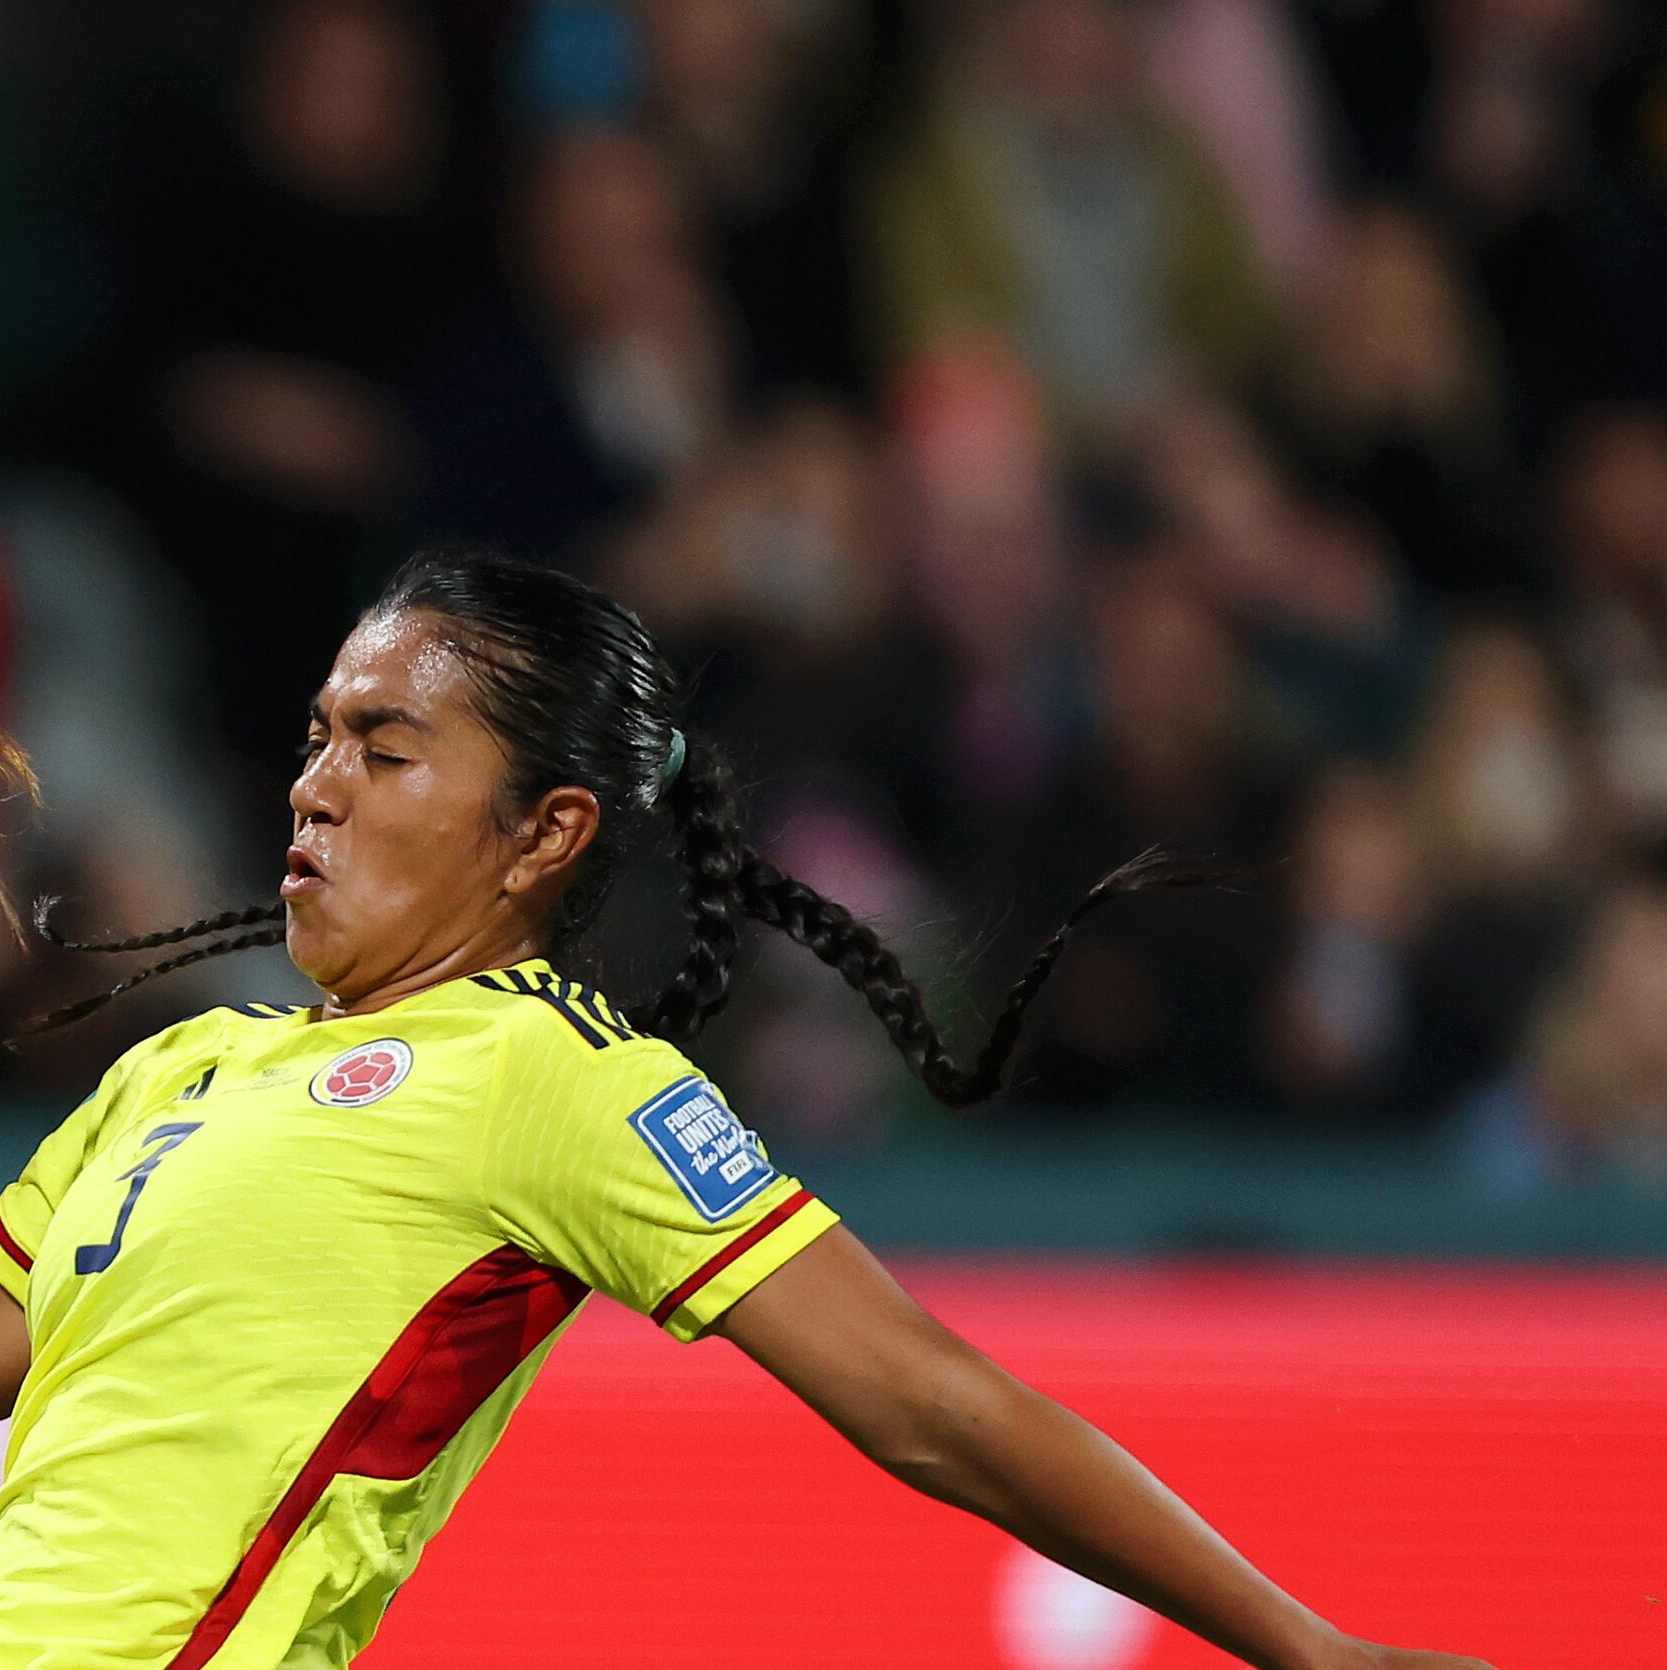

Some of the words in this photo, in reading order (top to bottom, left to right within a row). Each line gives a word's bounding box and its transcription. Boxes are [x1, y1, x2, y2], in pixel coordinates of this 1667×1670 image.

[662, 1093, 717, 1135] FOOTBALL
[675, 1107, 731, 1154] UNITES
[690, 1150, 718, 1176] the
